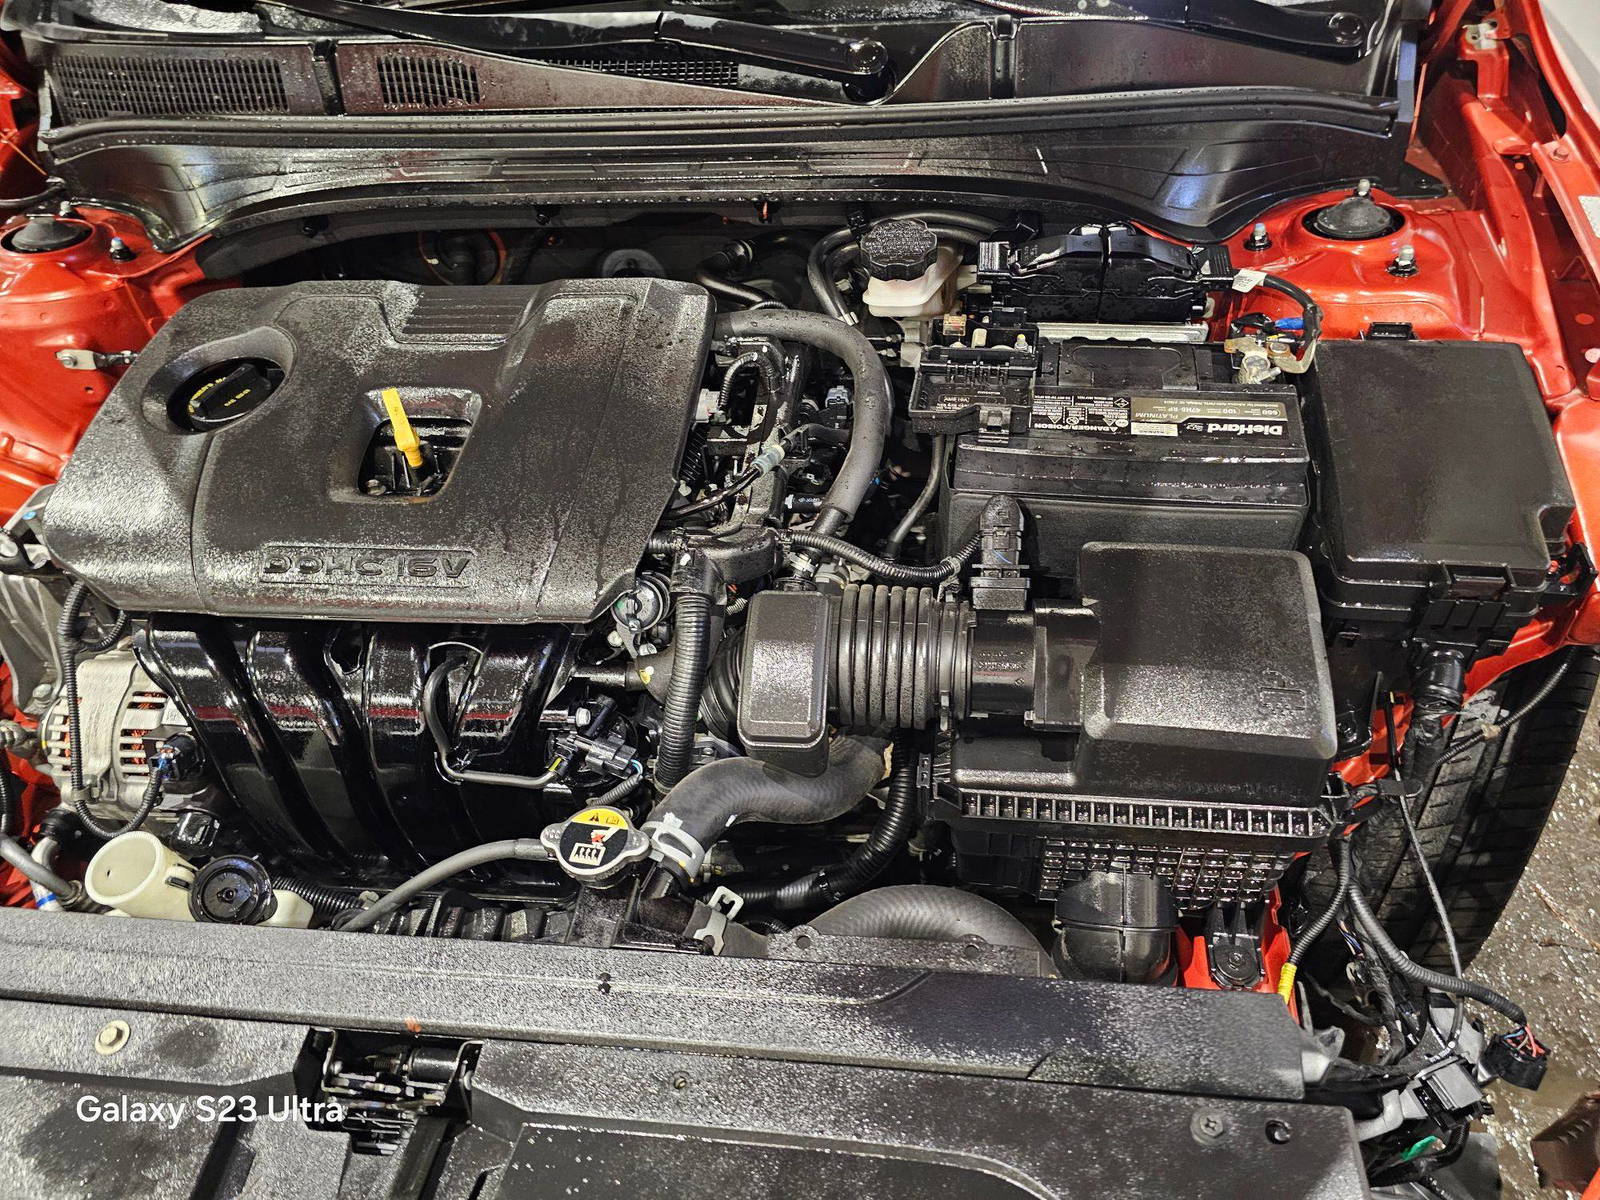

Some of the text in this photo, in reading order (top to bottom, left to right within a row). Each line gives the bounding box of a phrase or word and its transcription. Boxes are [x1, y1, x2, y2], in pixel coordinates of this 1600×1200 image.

[1135, 412, 1179, 420] PLATINUM
[1034, 423, 1110, 432] DANGER/POISON
[1207, 423, 1283, 436] DieHard
[263, 555, 471, 578] DOHC 16V
